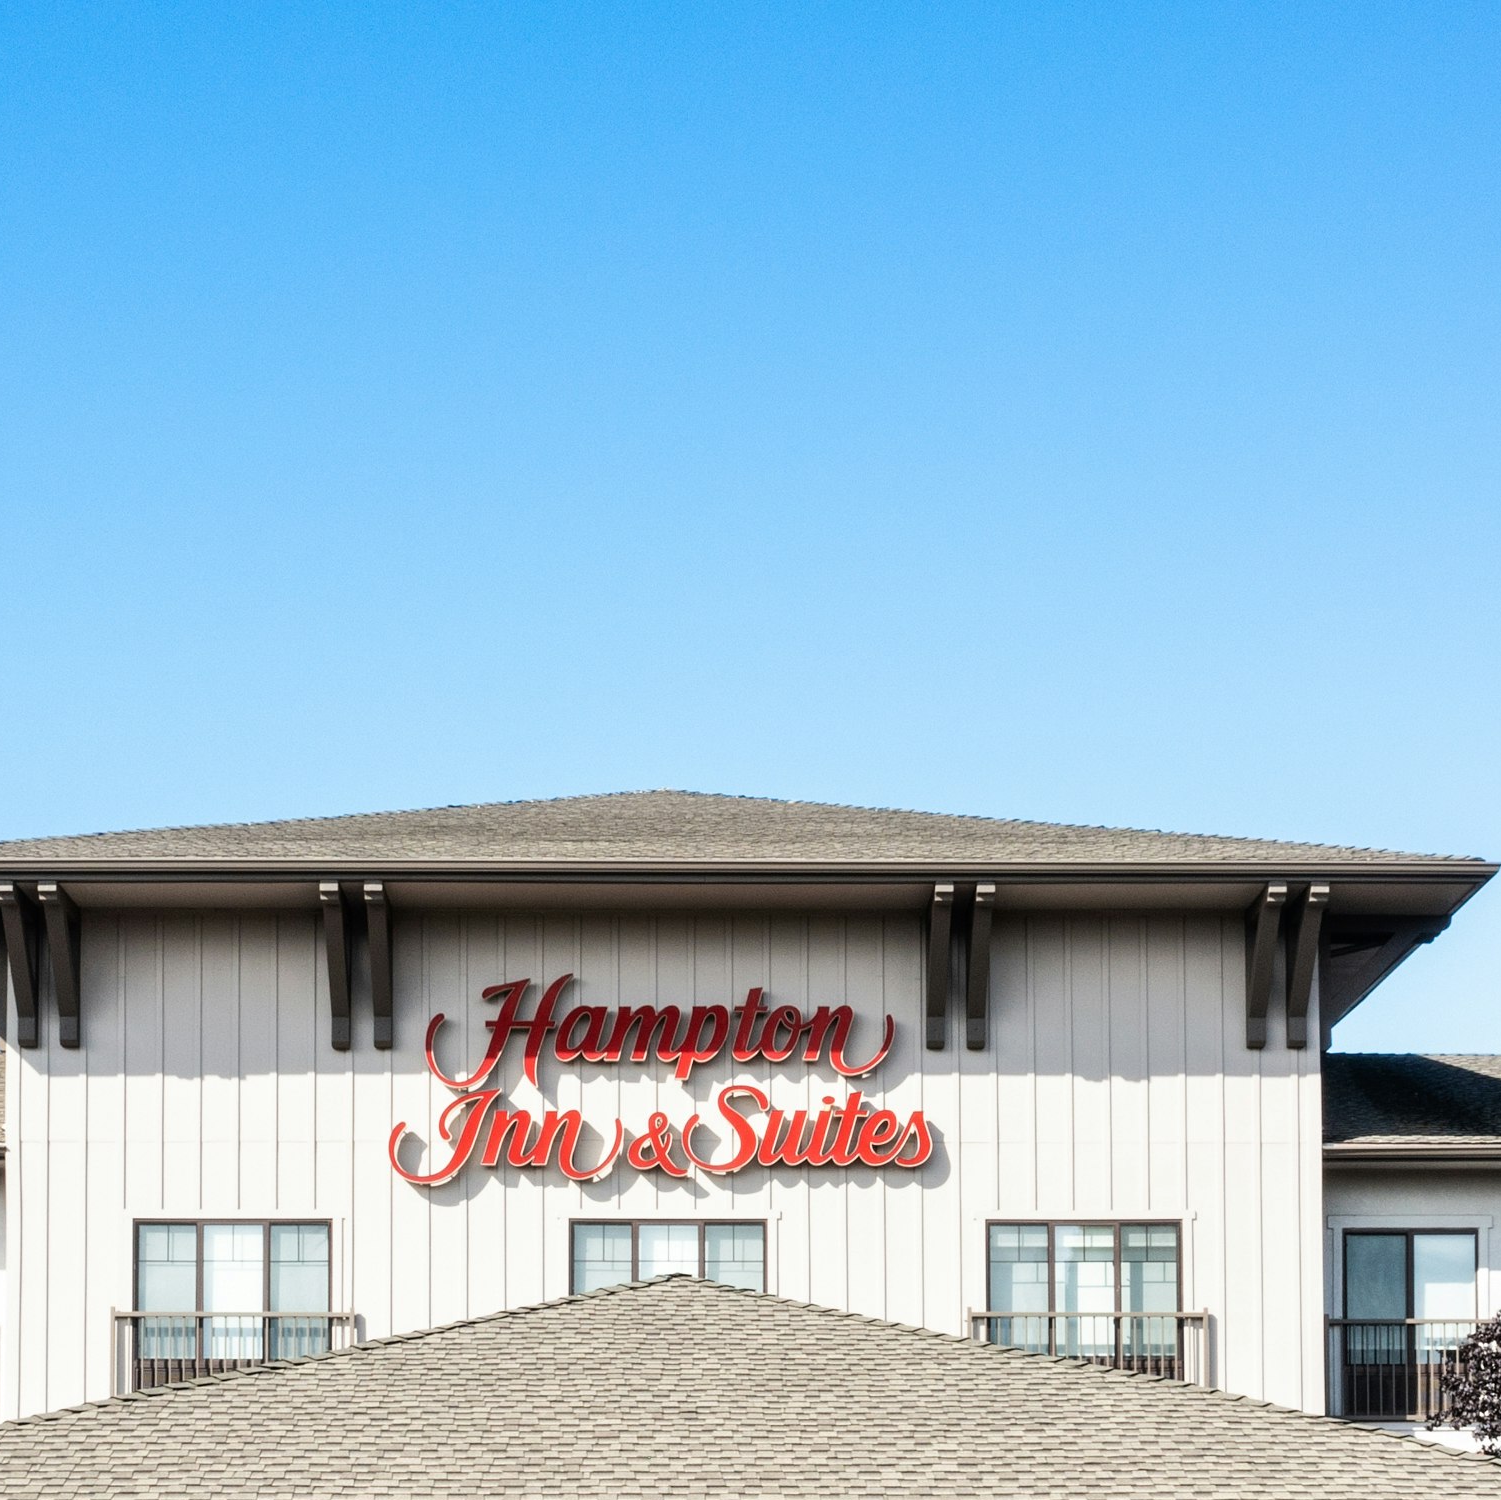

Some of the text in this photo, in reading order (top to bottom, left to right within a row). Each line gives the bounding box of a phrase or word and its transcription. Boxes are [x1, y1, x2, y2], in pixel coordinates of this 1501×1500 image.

[426, 973, 895, 1087] Hampton
[389, 1085, 933, 1185] Inn & Suites
